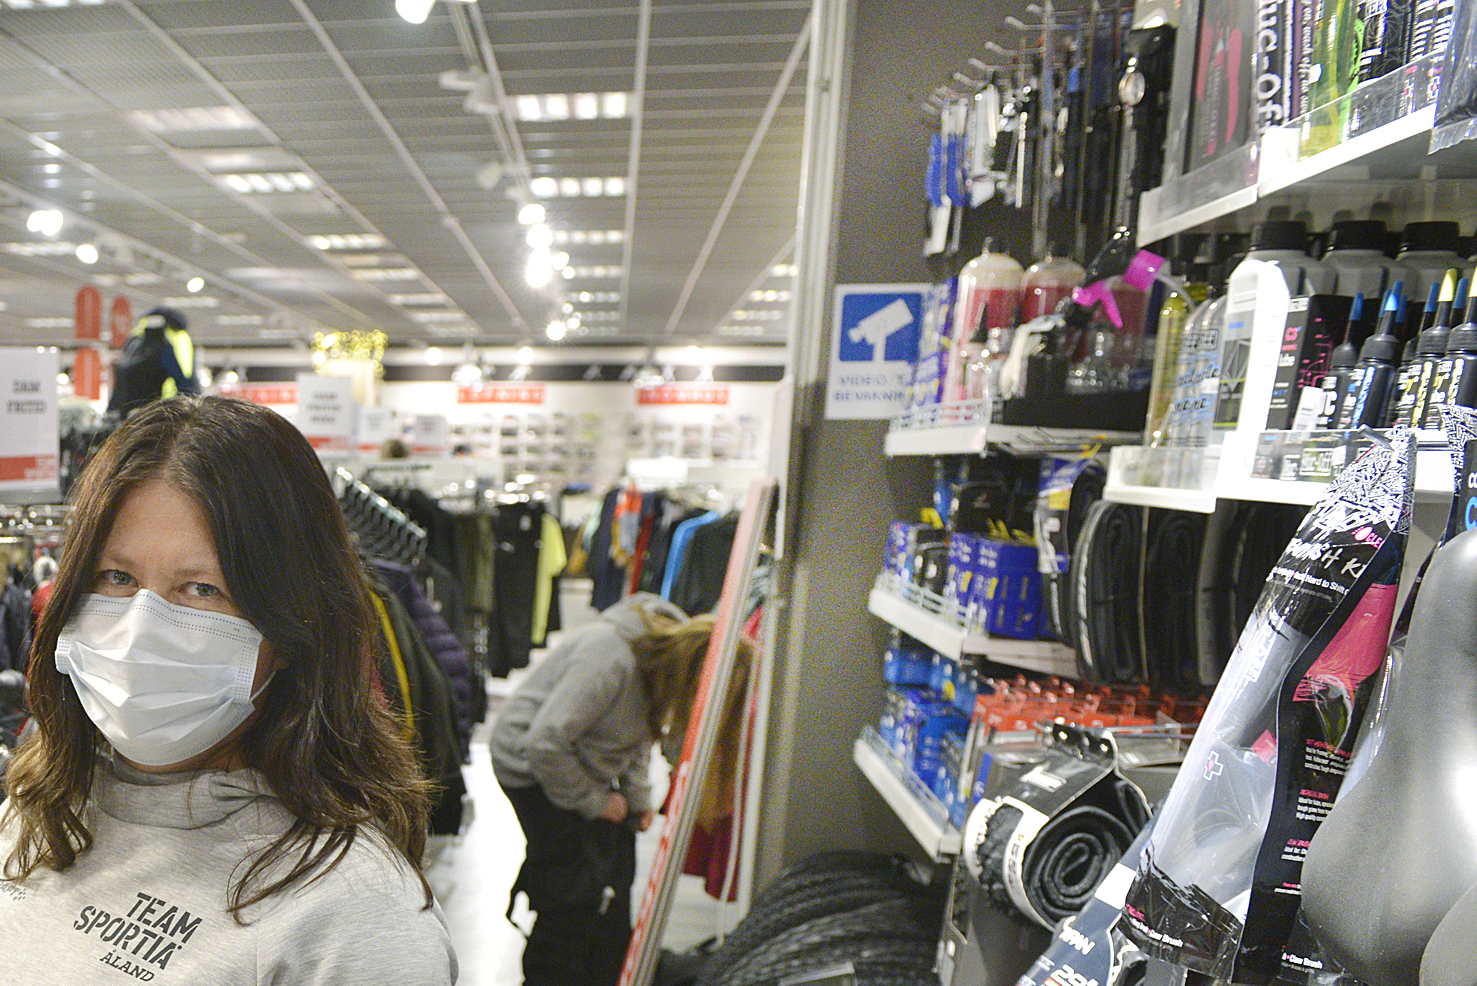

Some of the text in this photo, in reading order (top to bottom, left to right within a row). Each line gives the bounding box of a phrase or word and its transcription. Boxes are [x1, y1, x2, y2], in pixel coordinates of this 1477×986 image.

[1258, 0, 1283, 132] uc-Of
[73, 905, 176, 970] SPORTIA
[126, 891, 203, 943] TEAM
[1162, 933, 1184, 948] Brush
[99, 948, 155, 982] ÅLAND
[1303, 957, 1323, 969] Brush
